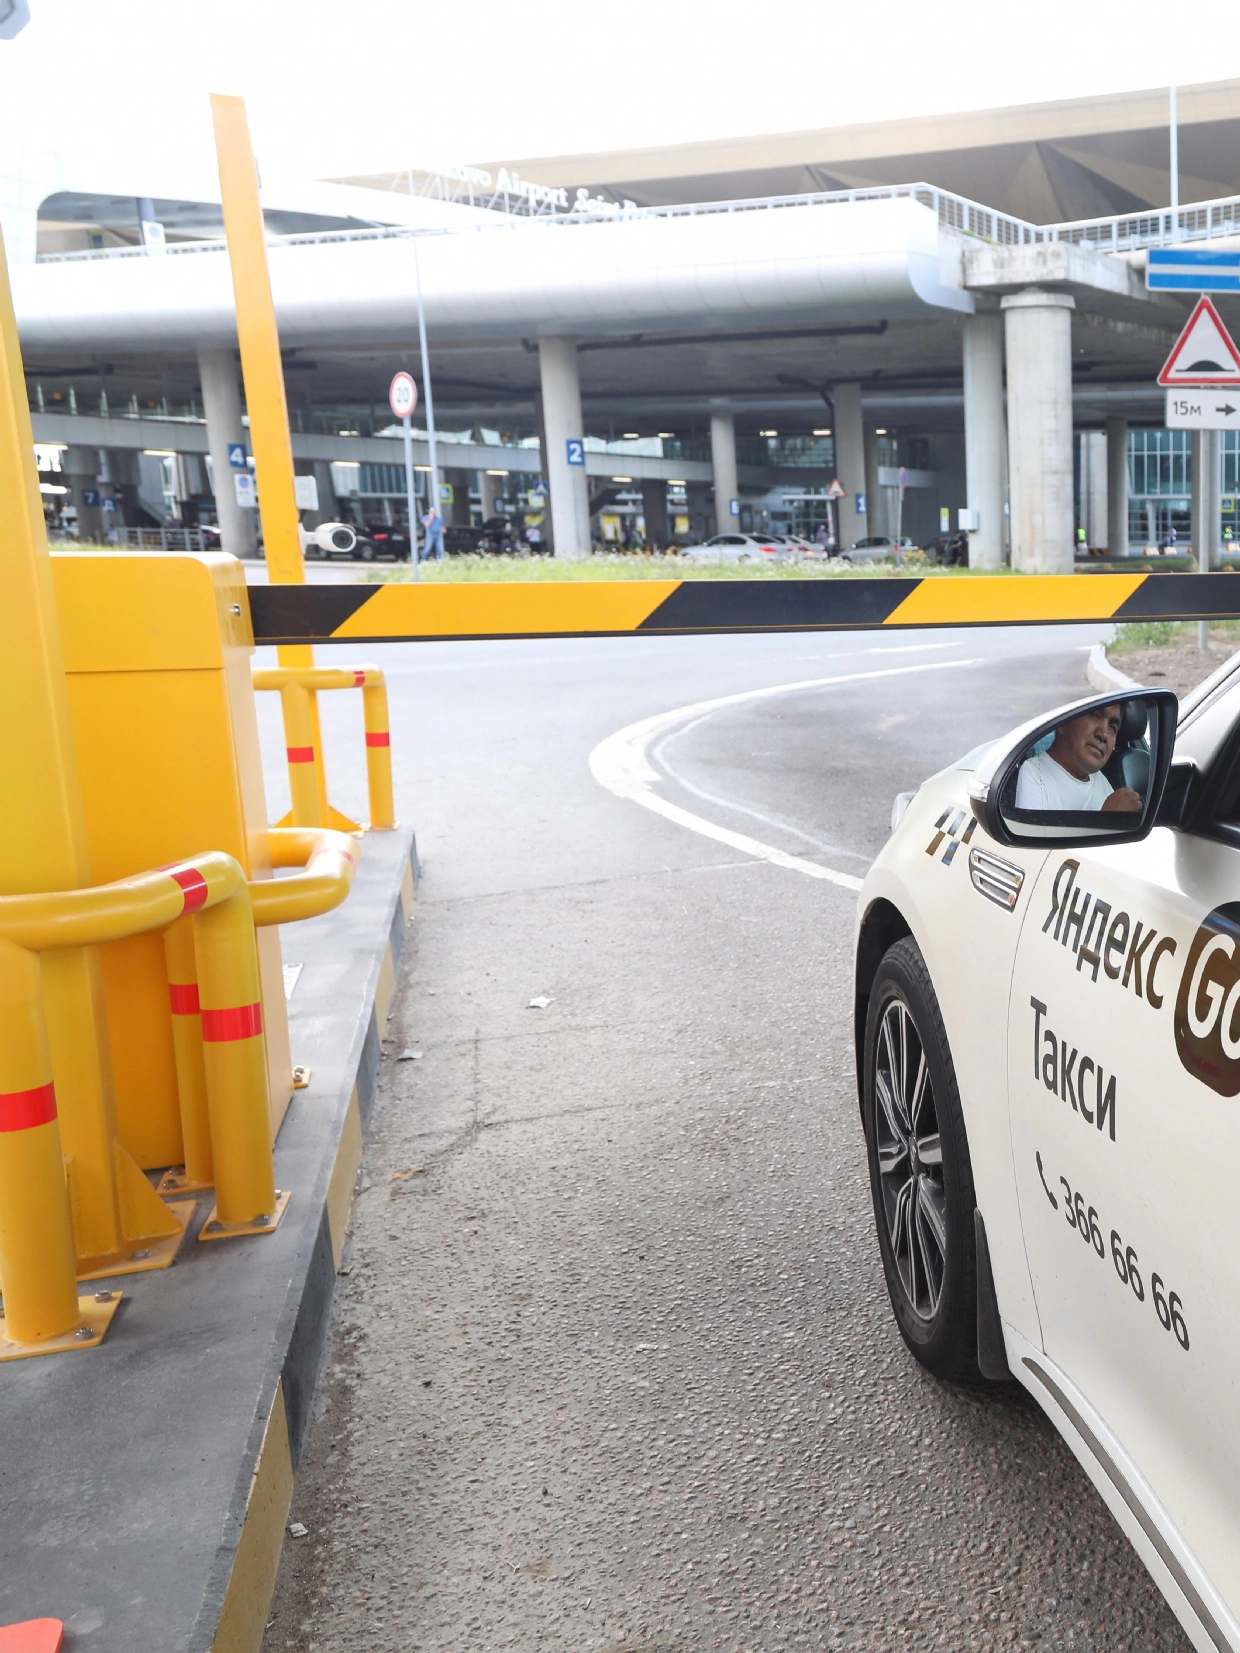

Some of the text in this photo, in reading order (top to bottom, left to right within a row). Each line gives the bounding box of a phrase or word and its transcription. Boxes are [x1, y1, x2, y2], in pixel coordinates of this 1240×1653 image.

[496, 168, 569, 208] Airport
[396, 387, 410, 403] 20
[1173, 401, 1202, 416] 15м
[230, 447, 245, 465] 4
[569, 443, 583, 462] 2
[84, 491, 95, 504] 7
[1041, 858, 1178, 1010] Яндекс
[1030, 995, 1117, 1142] Такси
[1060, 1175, 1190, 1351] 366 66 66
